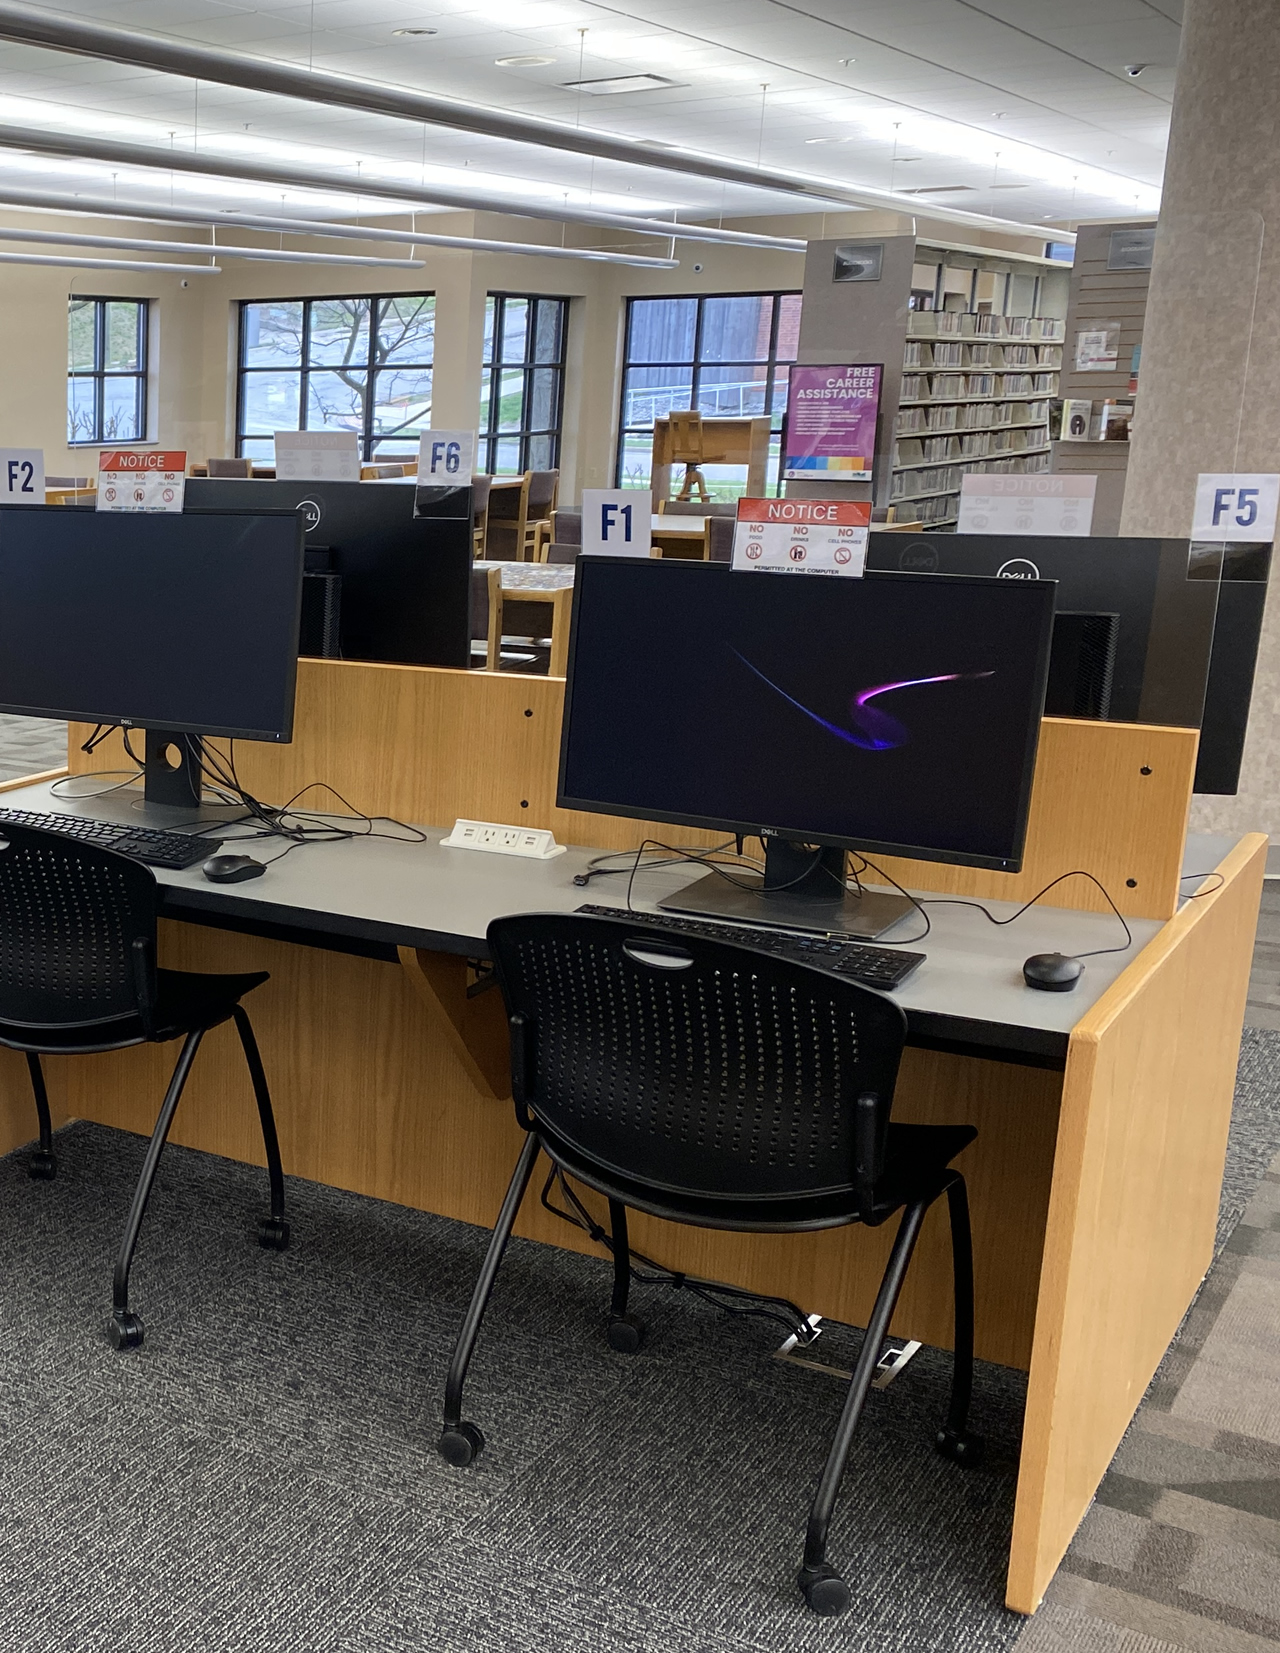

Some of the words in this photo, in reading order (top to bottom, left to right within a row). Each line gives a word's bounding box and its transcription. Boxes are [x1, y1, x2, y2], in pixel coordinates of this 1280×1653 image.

[846, 367, 876, 377] FREE
[826, 378, 874, 388] CAREER
[797, 388, 874, 399] ASSISTANCE
[119, 455, 165, 467] NOTICE
[430, 442, 460, 473] F6
[8, 461, 34, 492] F2
[768, 504, 838, 520] NOTICE
[1212, 489, 1259, 526] F5
[602, 504, 632, 542] F1
[749, 524, 764, 533] NO
[793, 526, 808, 535] NO
[838, 528, 853, 537] NO
[761, 828, 779, 836] DELL
